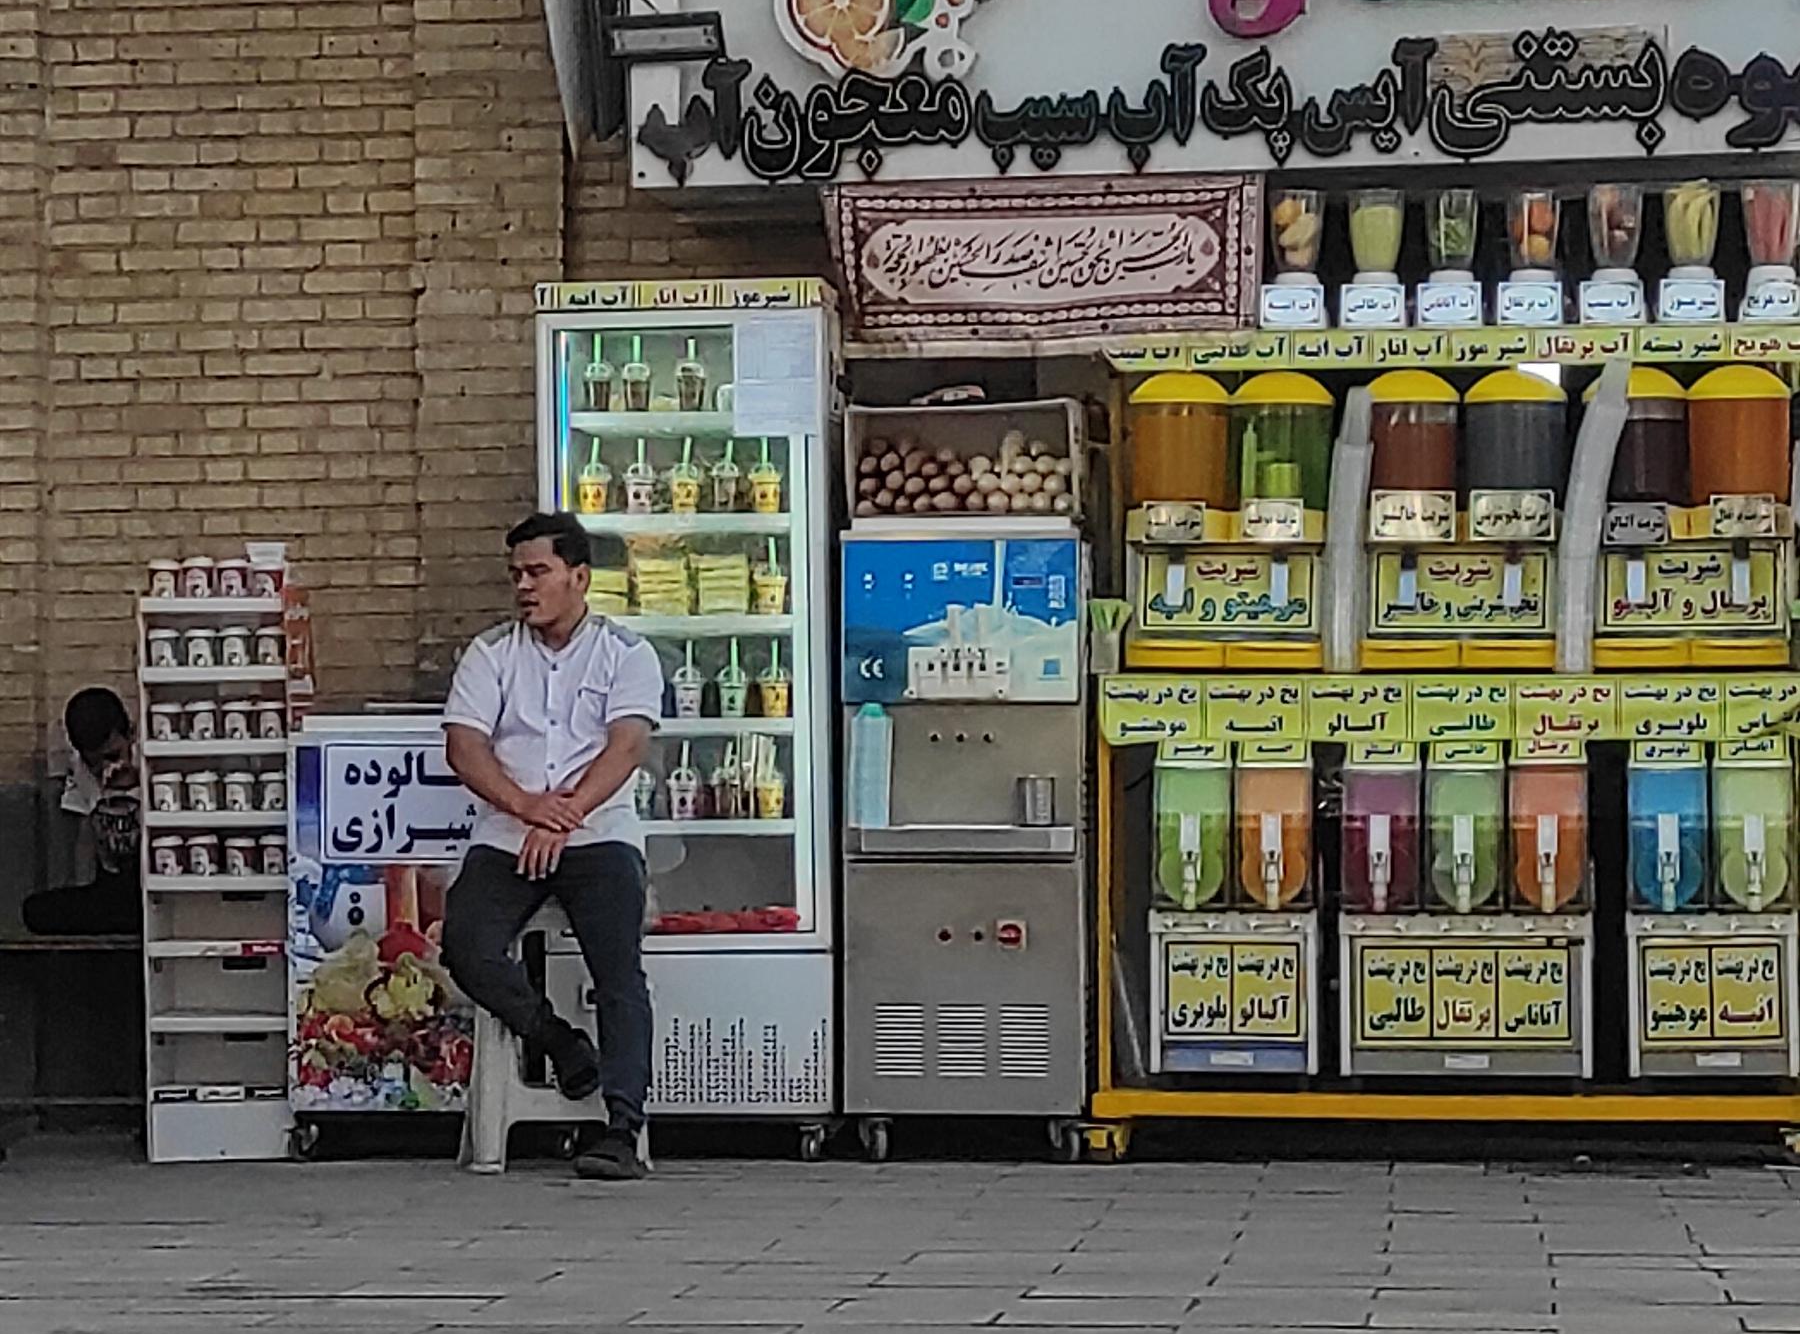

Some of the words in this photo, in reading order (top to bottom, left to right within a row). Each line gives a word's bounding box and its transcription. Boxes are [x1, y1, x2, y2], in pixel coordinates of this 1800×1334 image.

[1428, 26, 1668, 164] بستنی
[1104, 42, 1207, 176] آب
[1199, 47, 1294, 167] پک
[637, 55, 751, 188] آب
[740, 69, 973, 183] معجون
[975, 84, 1100, 175] سیب
[602, 285, 628, 307] آب
[682, 284, 708, 306] آب
[1256, 336, 1286, 364] آب
[1335, 335, 1365, 361] آب
[1377, 339, 1408, 362] انار
[1413, 335, 1445, 362] آب
[1198, 596, 1218, 622] و
[1682, 597, 1694, 618] و
[1105, 683, 1150, 705] بهشت
[1153, 685, 1174, 705] در
[1177, 684, 1198, 705] یخ
[1208, 684, 1252, 704] بهشت
[1255, 685, 1276, 706] در
[1279, 684, 1299, 705] یخ
[1311, 683, 1354, 704] بهشت
[1359, 685, 1379, 705] در
[1383, 684, 1403, 703] یخ
[1415, 683, 1460, 703] بهشت
[1465, 685, 1483, 704] در
[1488, 684, 1507, 703] یخ
[1519, 683, 1564, 703] بهشت
[1568, 684, 1588, 704] در
[1592, 684, 1612, 703] یخ
[1624, 683, 1669, 703] بهشت
[1673, 684, 1693, 704] در
[1697, 683, 1718, 703] یخ
[344, 750, 467, 799] الوده
[332, 803, 478, 854] شیرازی
[1171, 994, 1228, 1029] بلوبری
[1238, 995, 1291, 1028] آلبالو
[1369, 996, 1426, 1031] طالبی
[1435, 999, 1492, 1034] پرتقال
[1504, 1000, 1563, 1033] آناناس
[1718, 996, 1774, 1030] انبه
